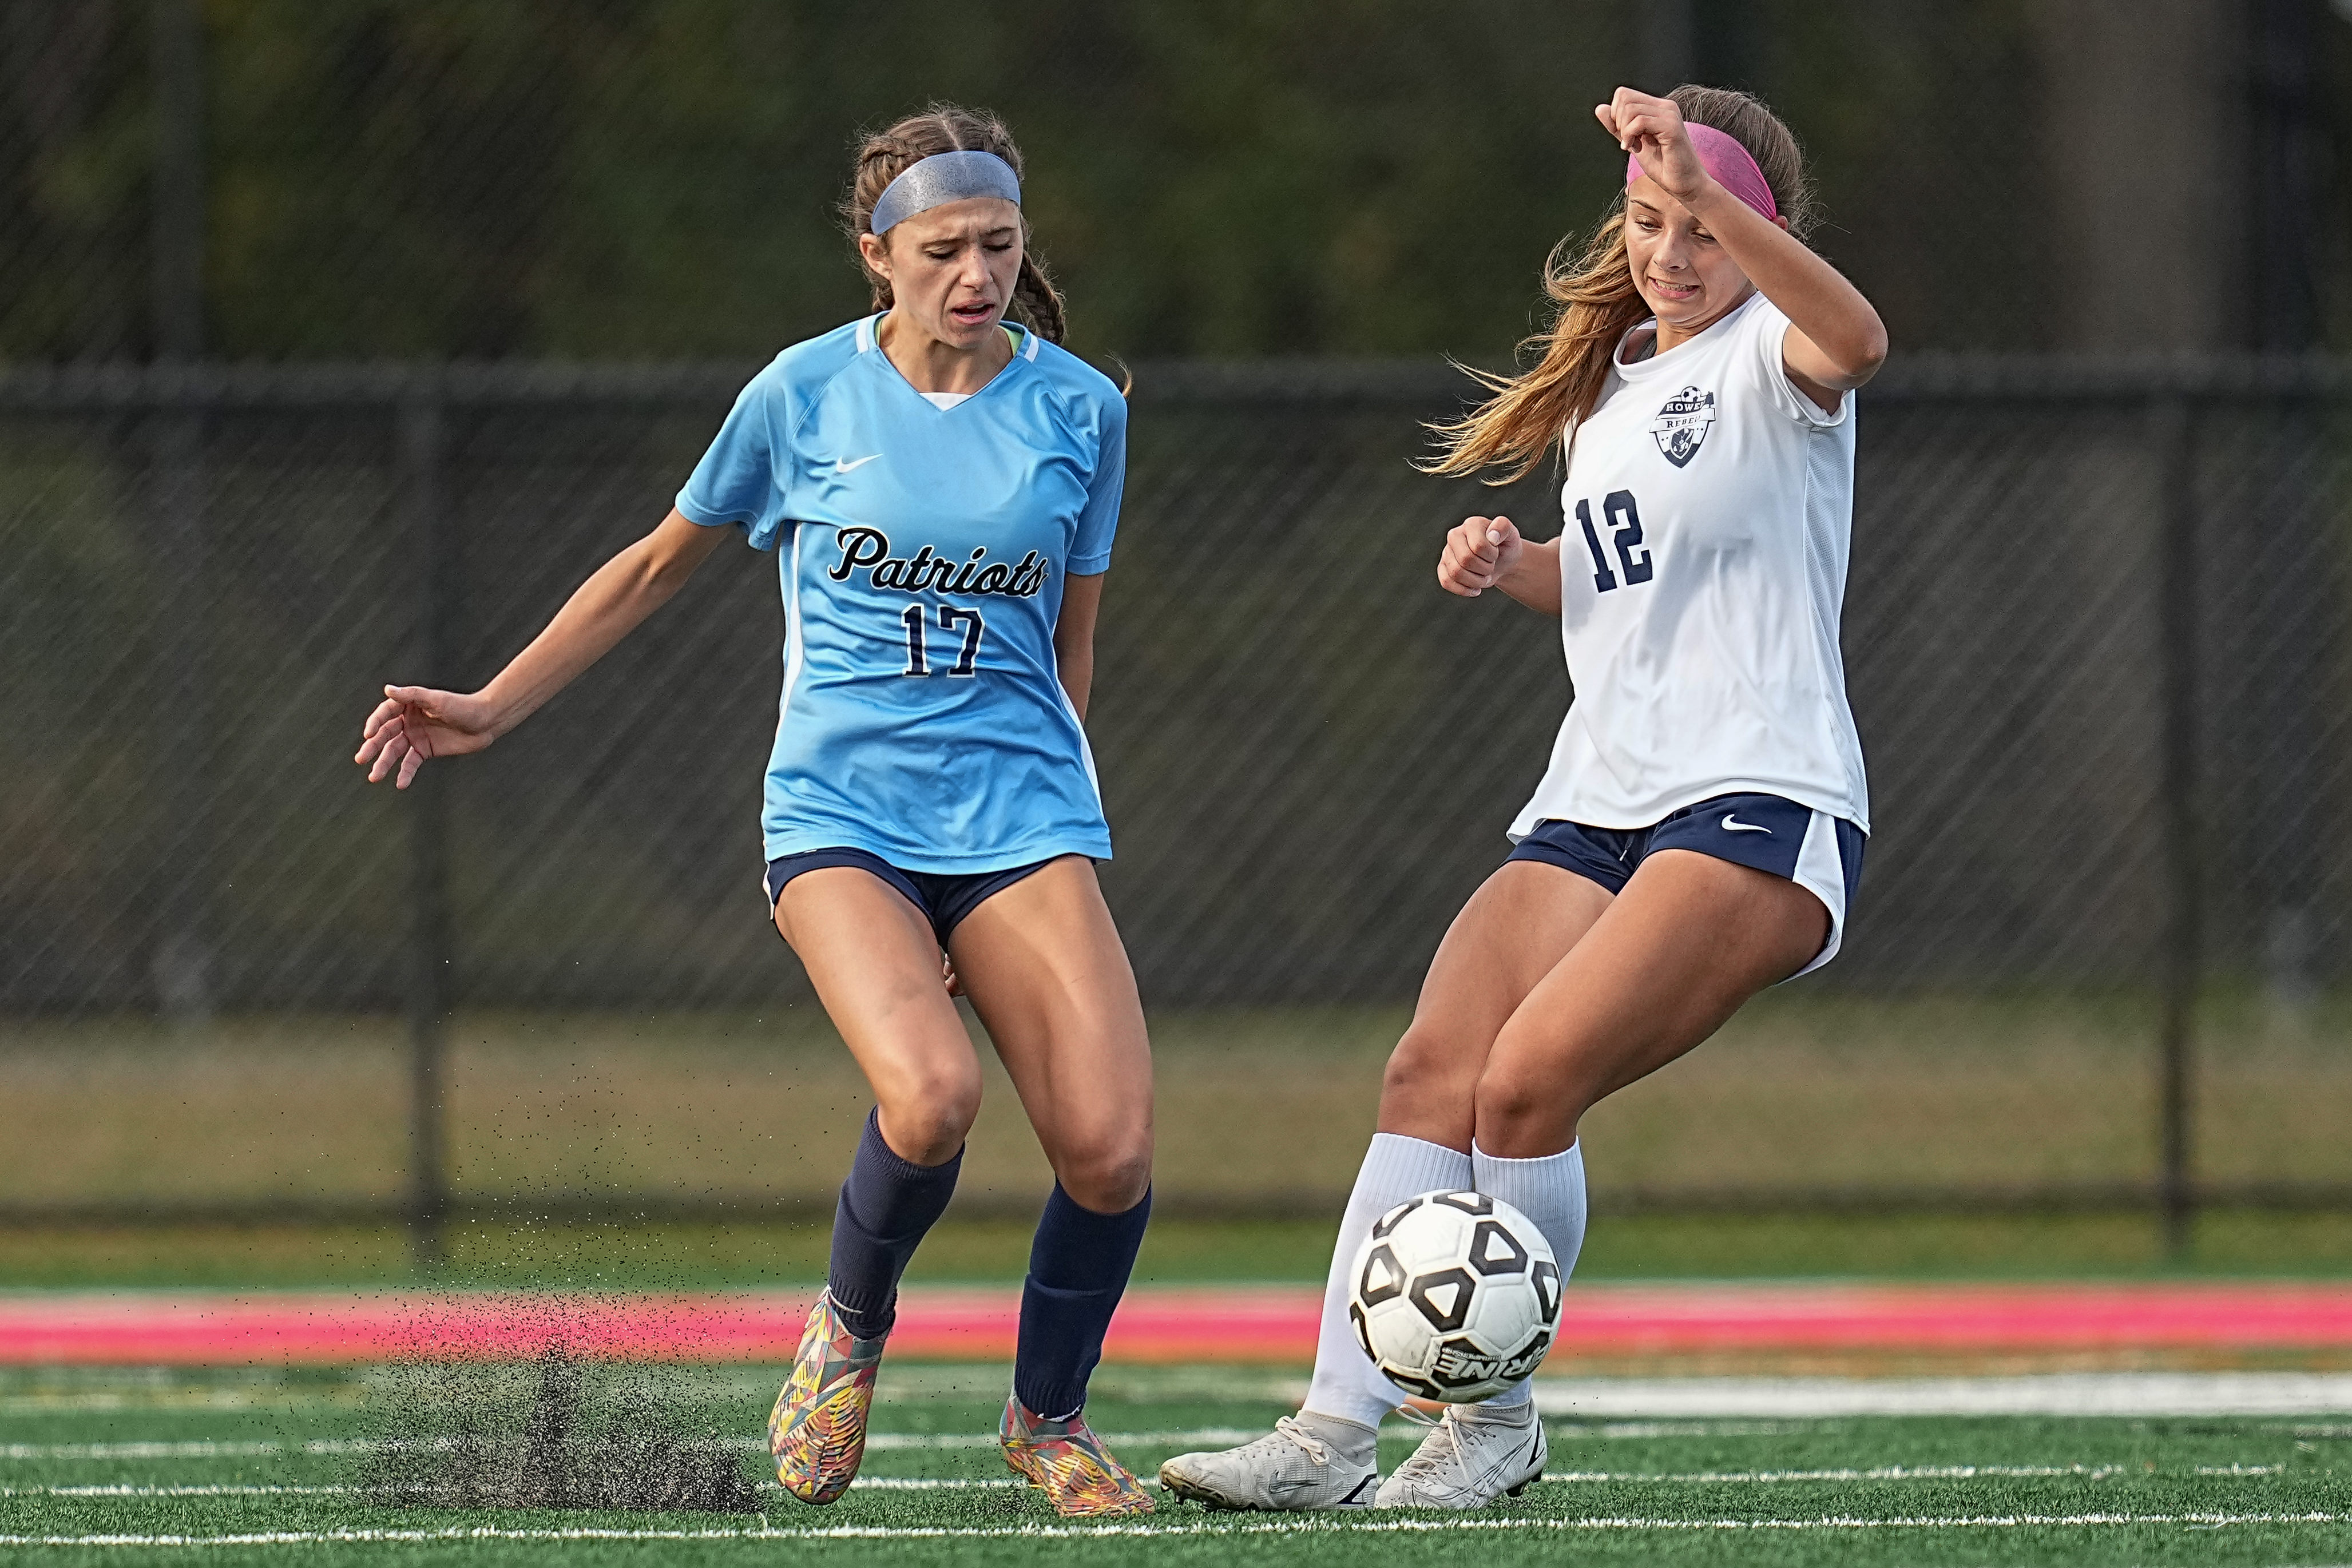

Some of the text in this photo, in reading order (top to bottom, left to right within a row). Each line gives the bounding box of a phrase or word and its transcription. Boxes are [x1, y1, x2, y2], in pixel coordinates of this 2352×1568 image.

[827, 525, 1049, 598] Patriots
[1576, 489, 1653, 593] 12
[901, 602, 985, 678] 17
